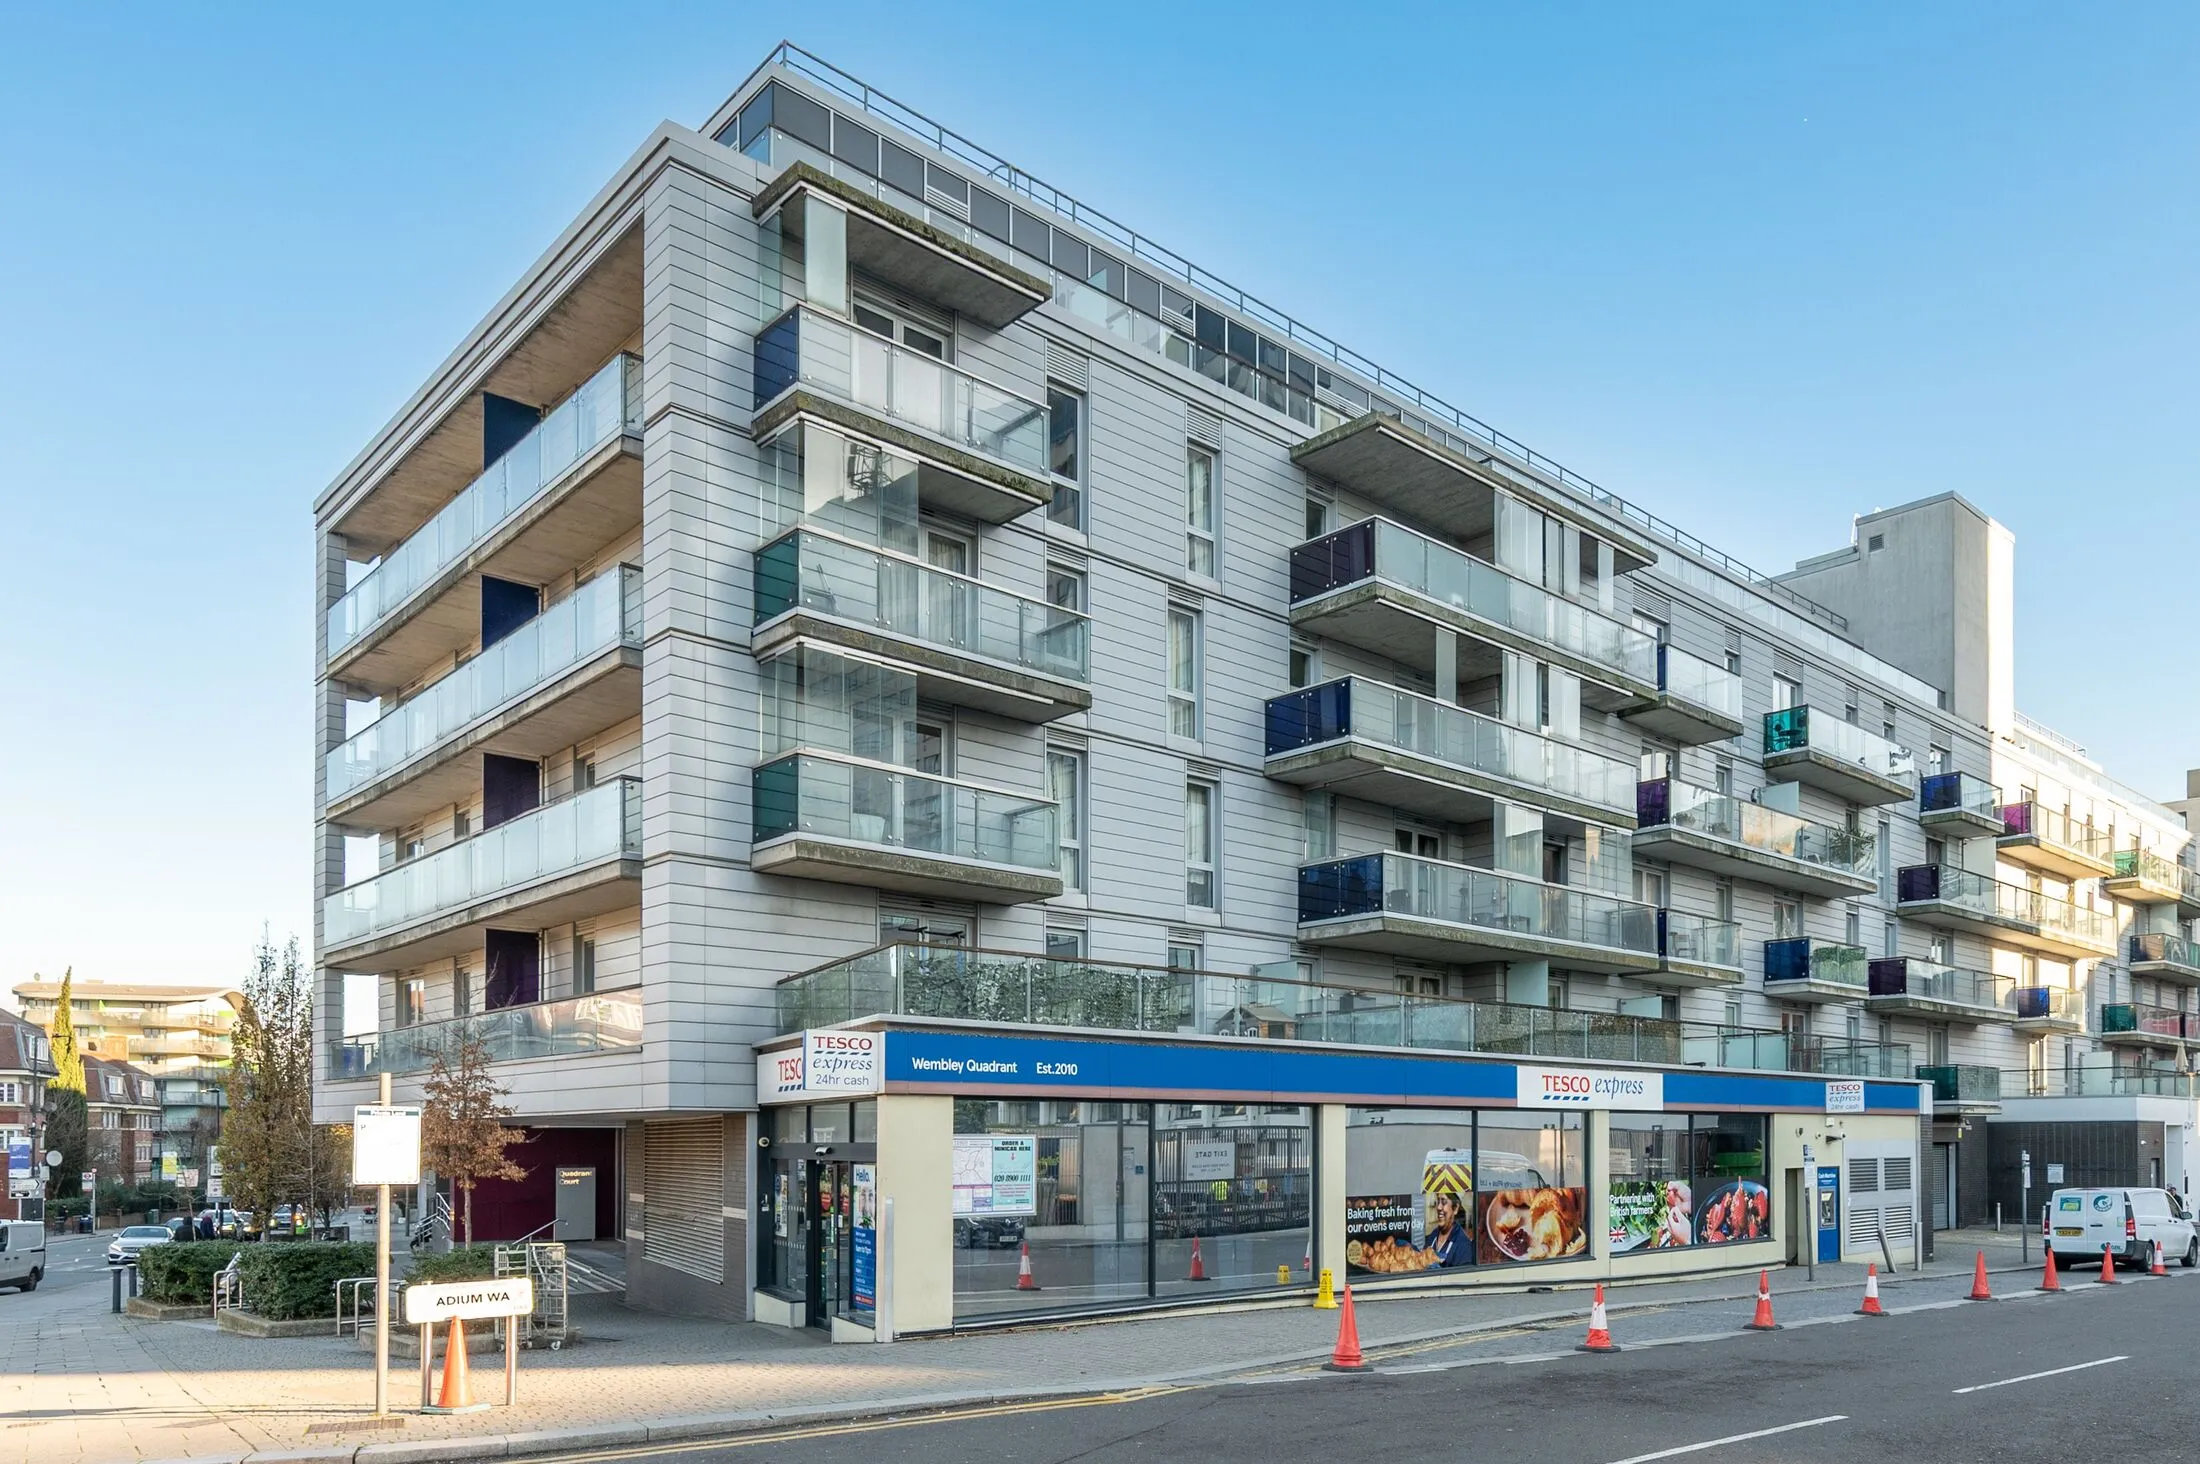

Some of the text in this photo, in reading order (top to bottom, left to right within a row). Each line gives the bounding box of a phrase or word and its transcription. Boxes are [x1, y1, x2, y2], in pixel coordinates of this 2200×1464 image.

[813, 1036, 872, 1050] TESCO
[778, 1058, 802, 1081] TESC
[813, 1057, 872, 1073] express
[912, 1057, 1078, 1075] Wembley Quadrant Est.2010
[816, 1074, 869, 1086] 24hr cash
[1542, 1075, 1643, 1099] TESCO express
[1829, 1084, 1860, 1092] TESCO
[1829, 1095, 1860, 1103] express
[559, 1170, 592, 1178] Quadrant
[1609, 1192, 1655, 1206] Partnering with
[1347, 1205, 1416, 1221] Baking fresh from
[1610, 1206, 1654, 1217] British farmers
[1347, 1219, 1425, 1233] our ovens every day
[436, 1292, 510, 1307] ADIUM WA
